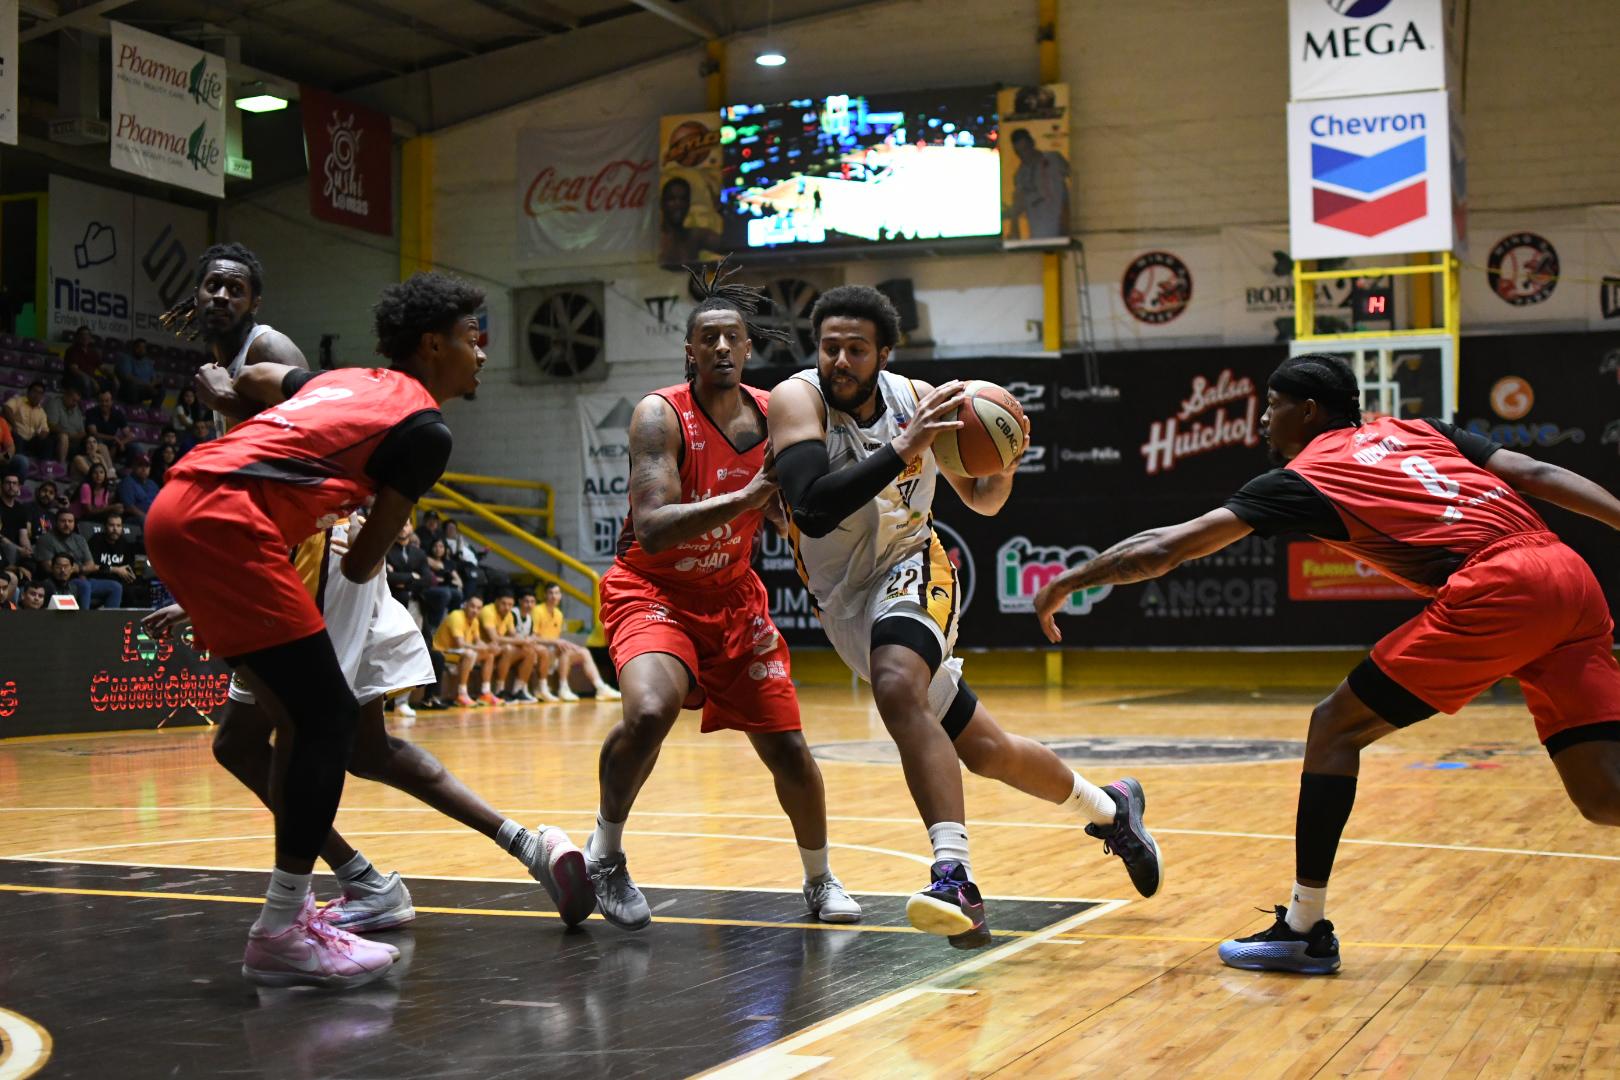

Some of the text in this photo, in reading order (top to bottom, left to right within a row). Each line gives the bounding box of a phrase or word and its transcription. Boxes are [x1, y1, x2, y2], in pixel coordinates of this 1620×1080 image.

[1303, 20, 1426, 62] MEGA
[117, 43, 188, 88] Pharma
[116, 112, 187, 156] Pharma
[1310, 112, 1427, 138] Chevron
[523, 160, 656, 217] Coca-Cola
[1178, 369, 1253, 420] Salsa
[1141, 396, 1259, 473] Huichol
[1140, 577, 1279, 609] ANCOR
